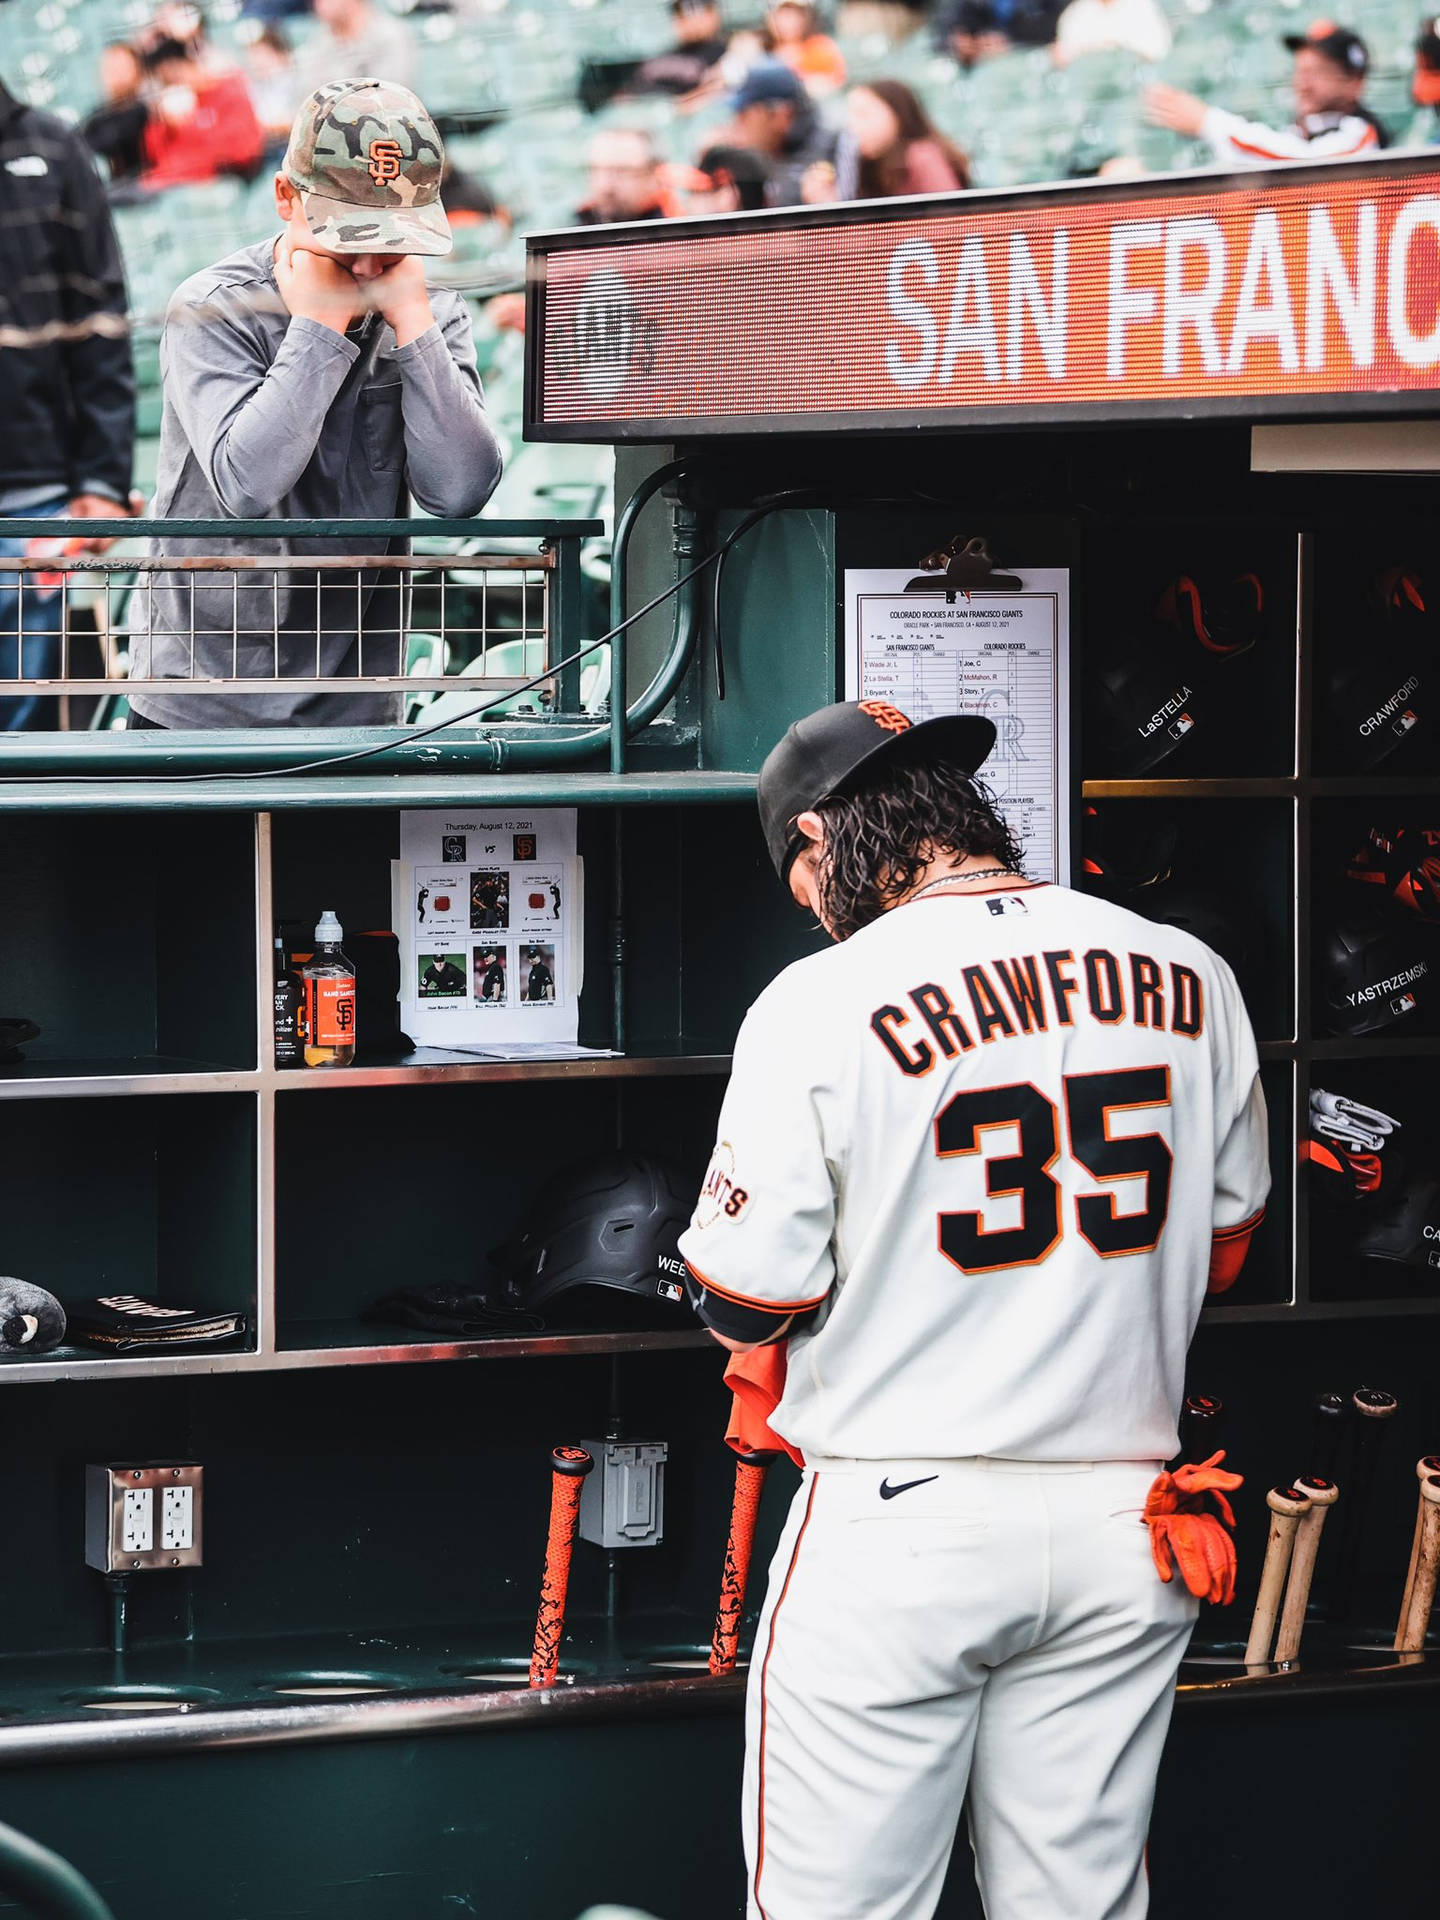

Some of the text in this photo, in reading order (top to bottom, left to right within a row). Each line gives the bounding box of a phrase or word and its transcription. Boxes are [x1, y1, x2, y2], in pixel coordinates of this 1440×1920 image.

[885, 228, 1068, 388] SAN
[956, 610, 968, 618] SAN
[969, 610, 1000, 618] FRANCISCO
[1002, 610, 1023, 618] GIANTS
[1138, 686, 1192, 738] LaSTELLA
[1360, 676, 1419, 736] CRAWFORD
[445, 823, 478, 831] Thursday,
[479, 823, 502, 831] August
[870, 948, 1204, 1078] CRAWFORD
[934, 1064, 1174, 1275] 35
